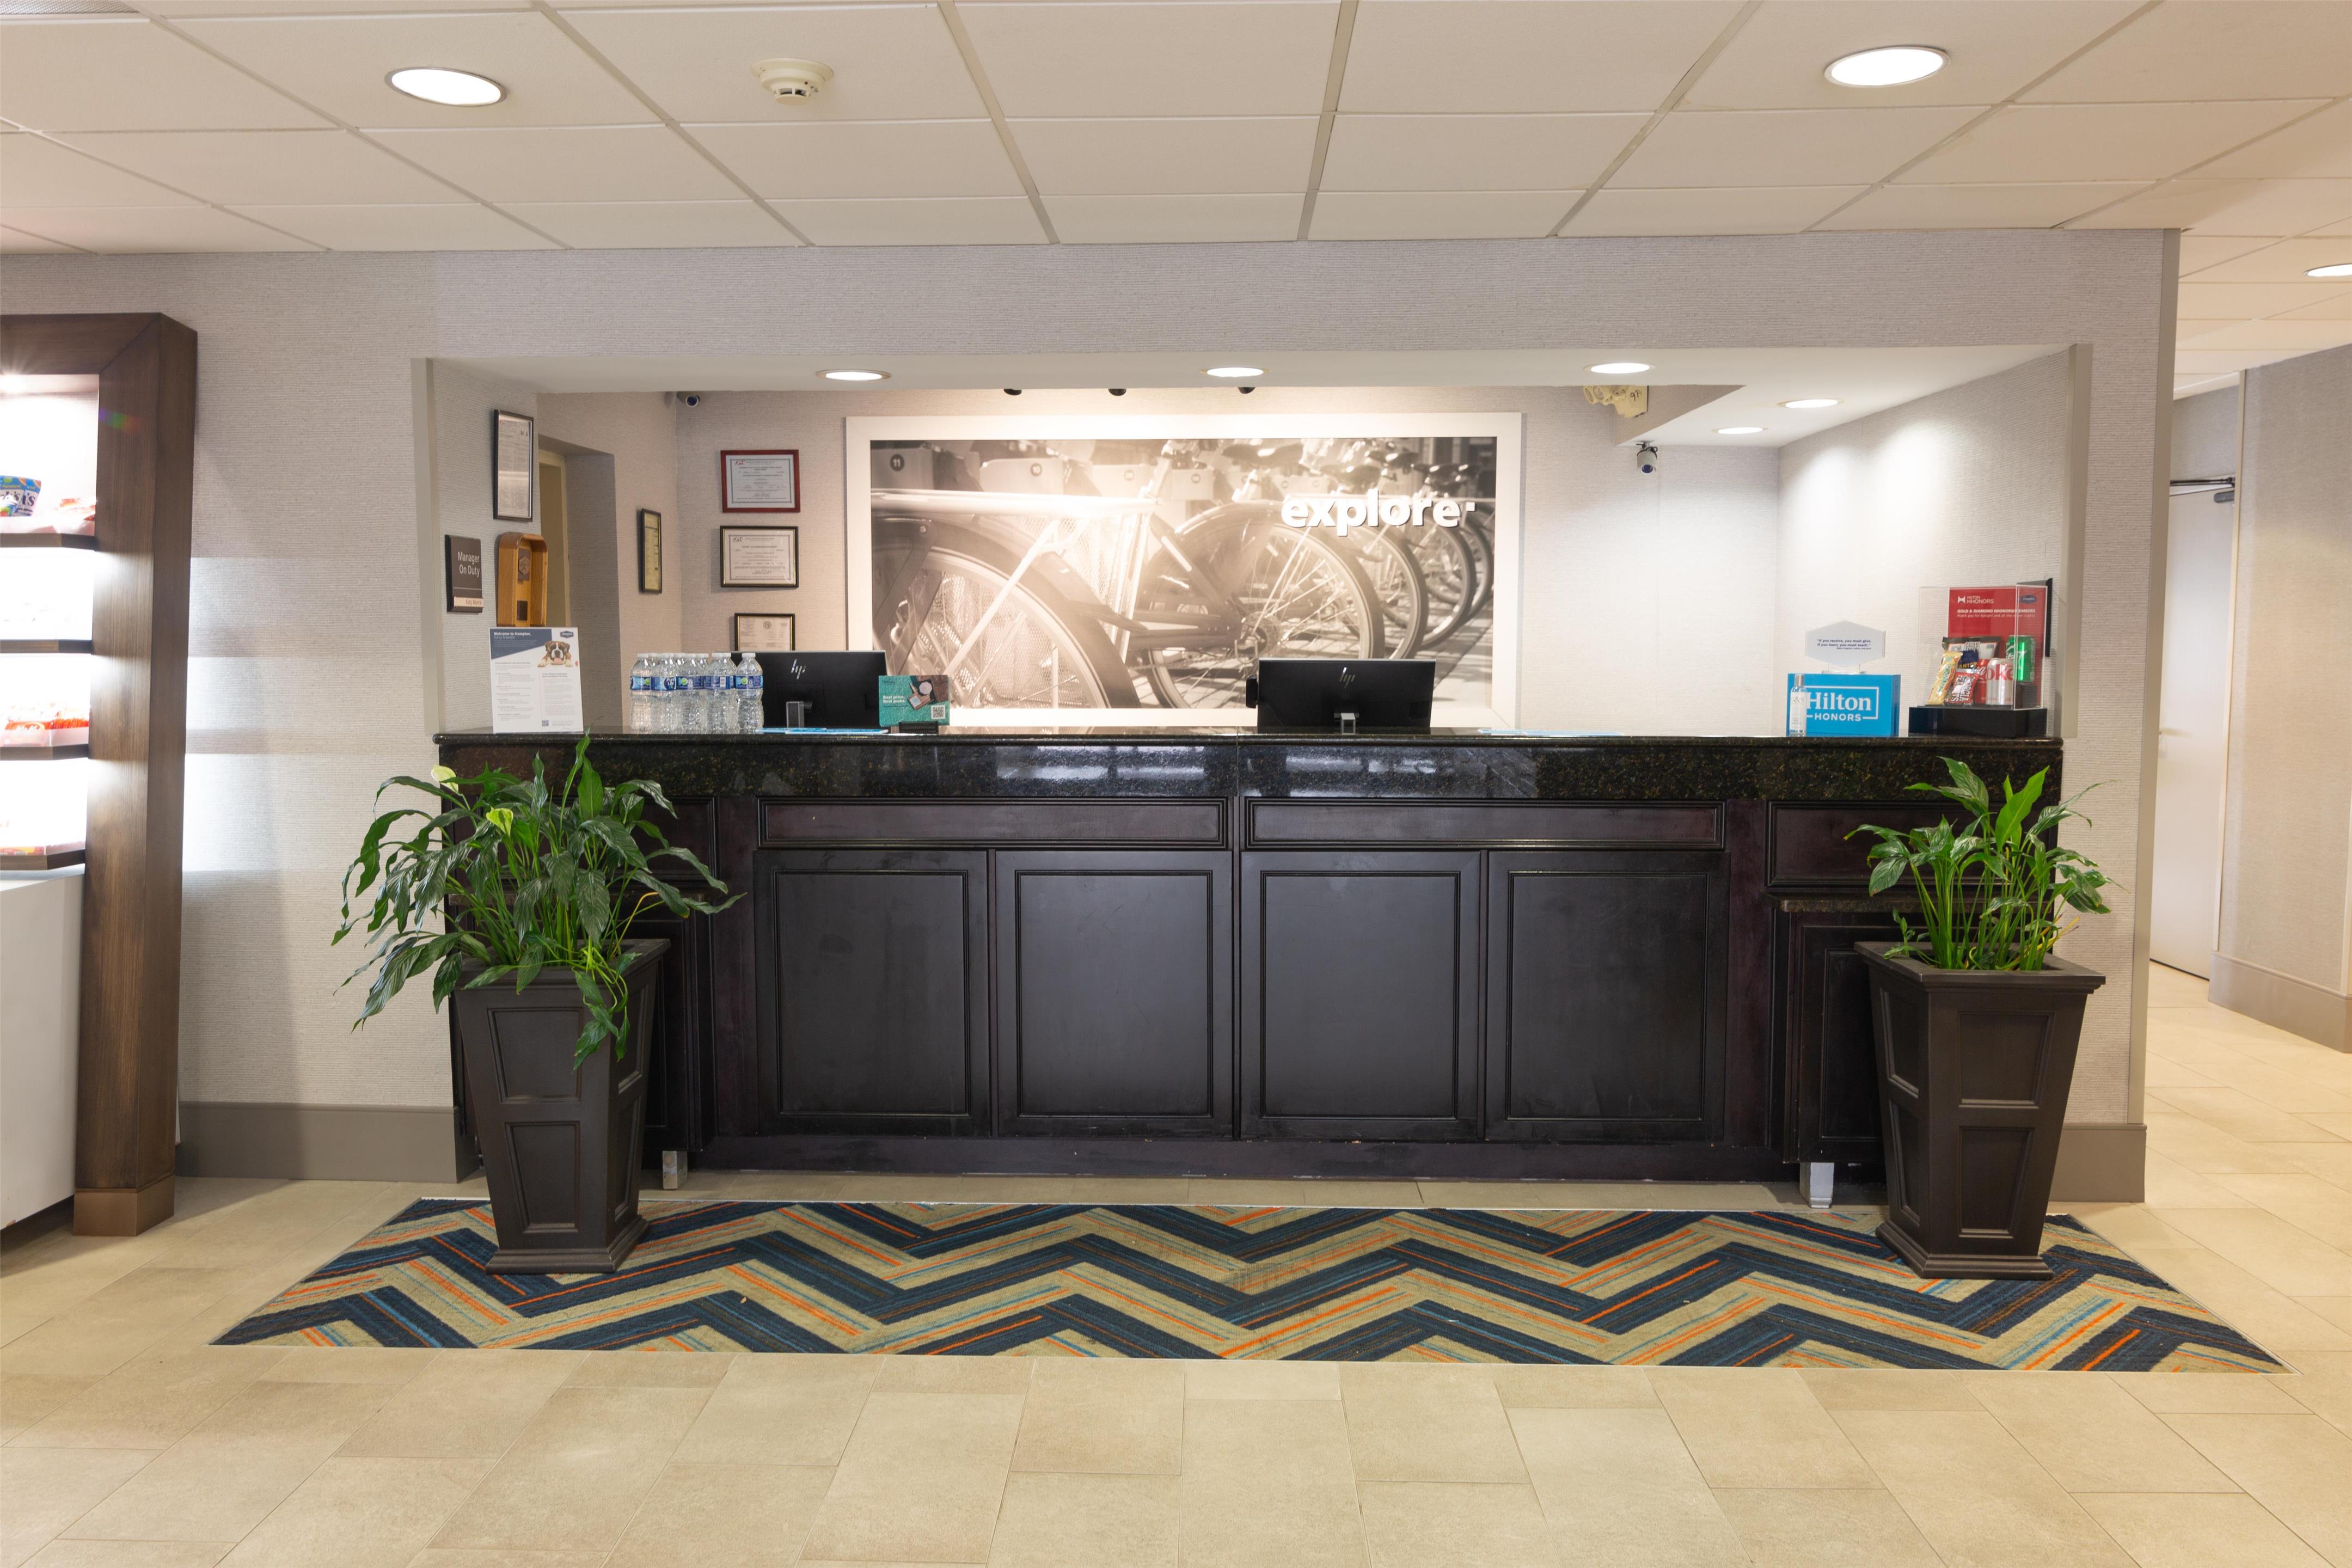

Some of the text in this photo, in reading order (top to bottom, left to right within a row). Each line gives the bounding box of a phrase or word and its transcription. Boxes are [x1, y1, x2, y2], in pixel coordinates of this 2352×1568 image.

[892, 458, 901, 468] 11
[1281, 487, 1461, 537] explore
[458, 551, 480, 565] Manager
[459, 564, 480, 578] On Duty
[791, 658, 806, 680] hp
[1806, 691, 1872, 711] Hilton
[1814, 713, 1861, 721] HONORS
